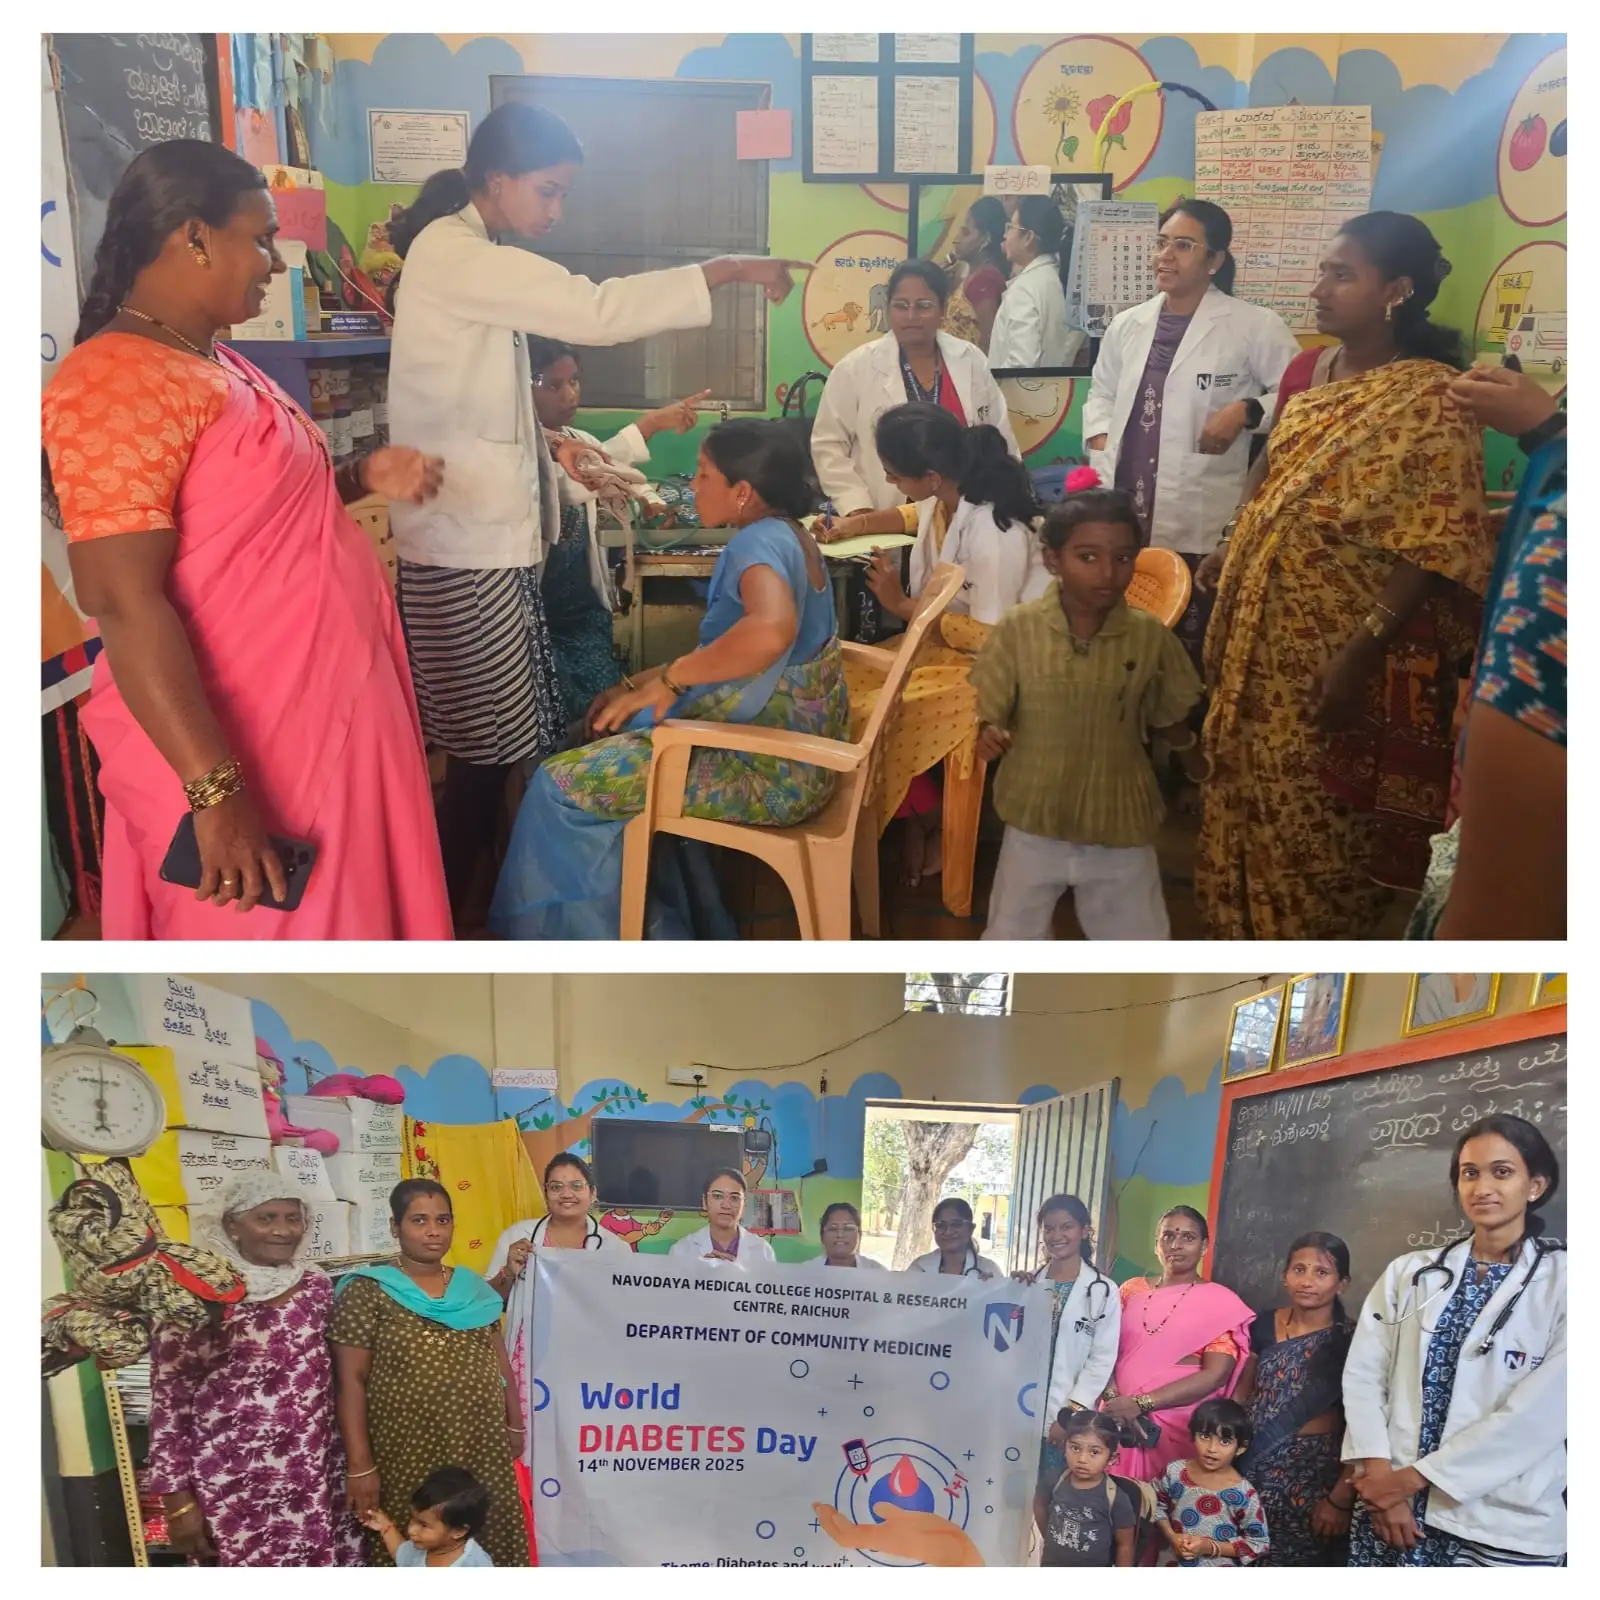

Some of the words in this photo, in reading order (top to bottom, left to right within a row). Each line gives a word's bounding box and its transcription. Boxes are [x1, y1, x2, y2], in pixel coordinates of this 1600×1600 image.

[1273, 1089, 1332, 1120] 14/11/25
[612, 1274, 691, 1290] NAVODAYA
[694, 1279, 752, 1294] MEDICAL
[755, 1282, 811, 1298] COLLEGE
[814, 1287, 879, 1303] HOSPITAL
[883, 1292, 893, 1304] &
[897, 1293, 968, 1310] RESEARCH
[733, 1300, 788, 1315] CENTRE,
[791, 1304, 850, 1319] RAICHUR
[626, 1323, 740, 1343] DEPARTMENT
[745, 1329, 766, 1344] OF
[771, 1331, 869, 1353] COMMUNITY
[873, 1339, 952, 1358] MEDICINE
[580, 1382, 681, 1410] World
[579, 1424, 746, 1453] DIABETES
[756, 1427, 818, 1463] Day
[577, 1458, 609, 1473] 14th
[612, 1457, 701, 1472] NOVEMBER
[705, 1458, 745, 1472] 2025
